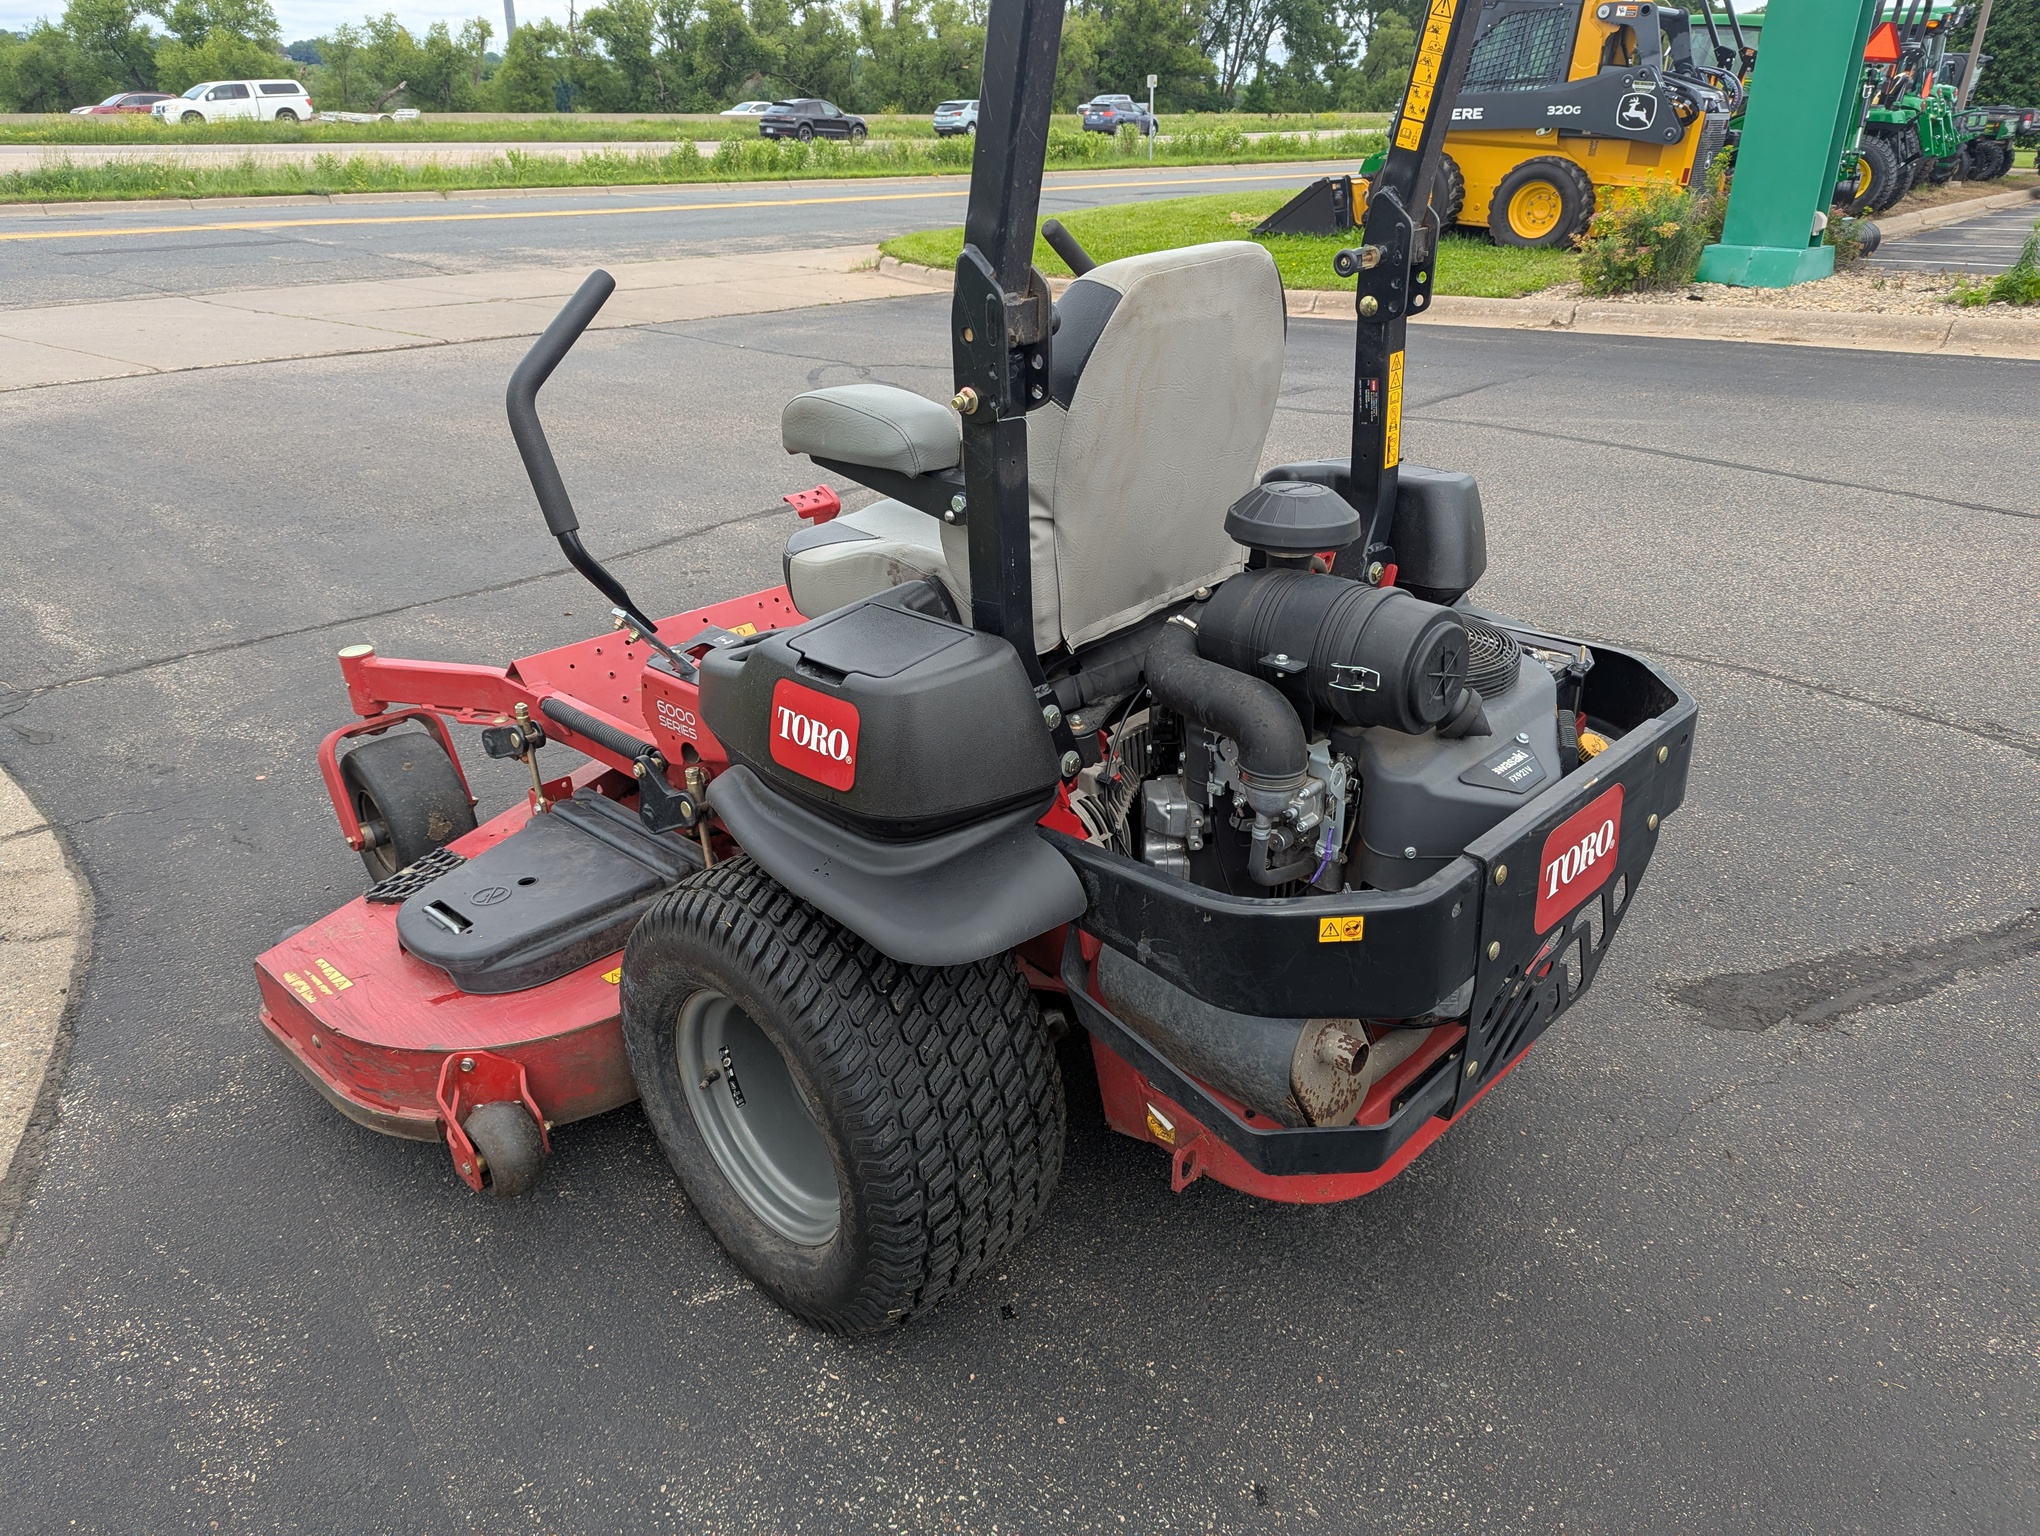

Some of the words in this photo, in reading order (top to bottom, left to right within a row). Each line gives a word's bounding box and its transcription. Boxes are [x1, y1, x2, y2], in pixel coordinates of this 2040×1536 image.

[1451, 107, 1484, 120] ERE
[1547, 105, 1582, 115] 320G
[656, 700, 696, 726] 6000
[658, 716, 697, 740] SERIES
[777, 706, 850, 762] TORO
[1508, 765, 1533, 783] FX921V
[1545, 819, 1614, 899] TORO
